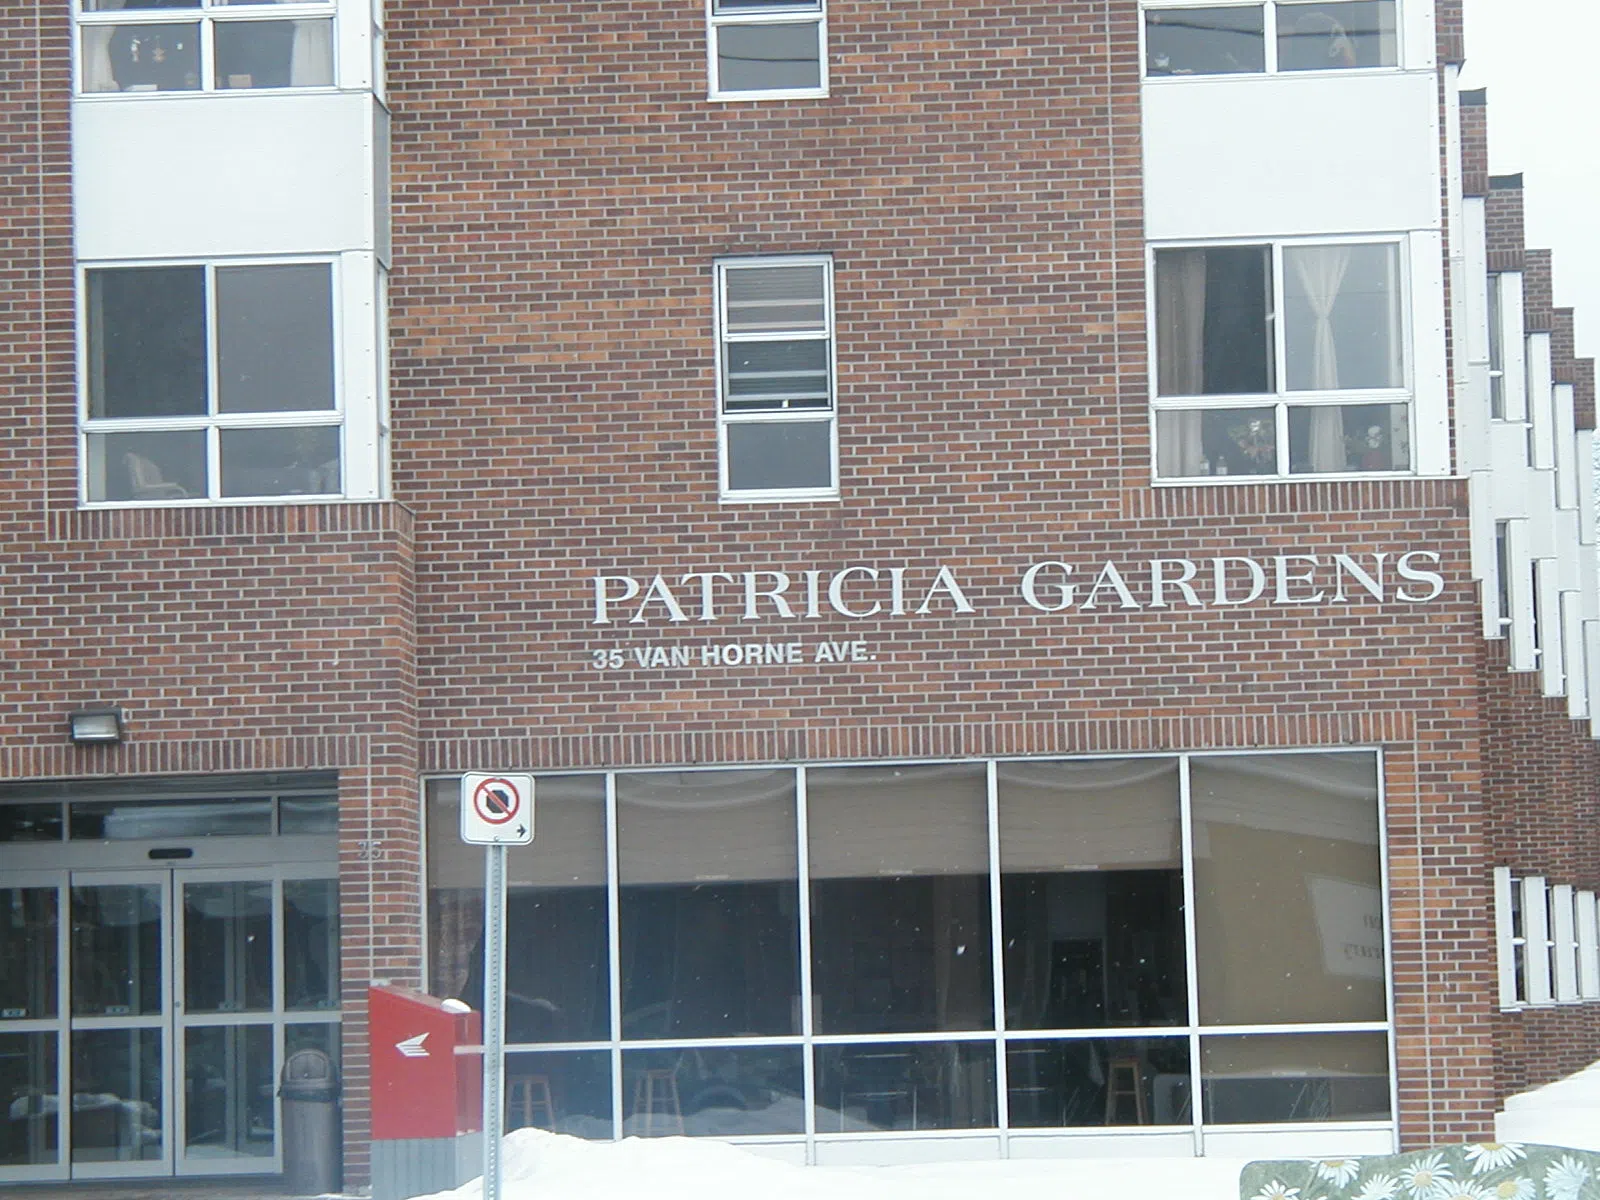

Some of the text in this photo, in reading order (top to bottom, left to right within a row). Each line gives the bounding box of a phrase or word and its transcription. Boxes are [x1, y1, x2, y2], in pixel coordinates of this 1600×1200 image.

[591, 550, 1445, 625] PATRICIA GARDENS
[592, 640, 877, 670] 35 VAN HORNE AVE.
[357, 841, 382, 859] 35
